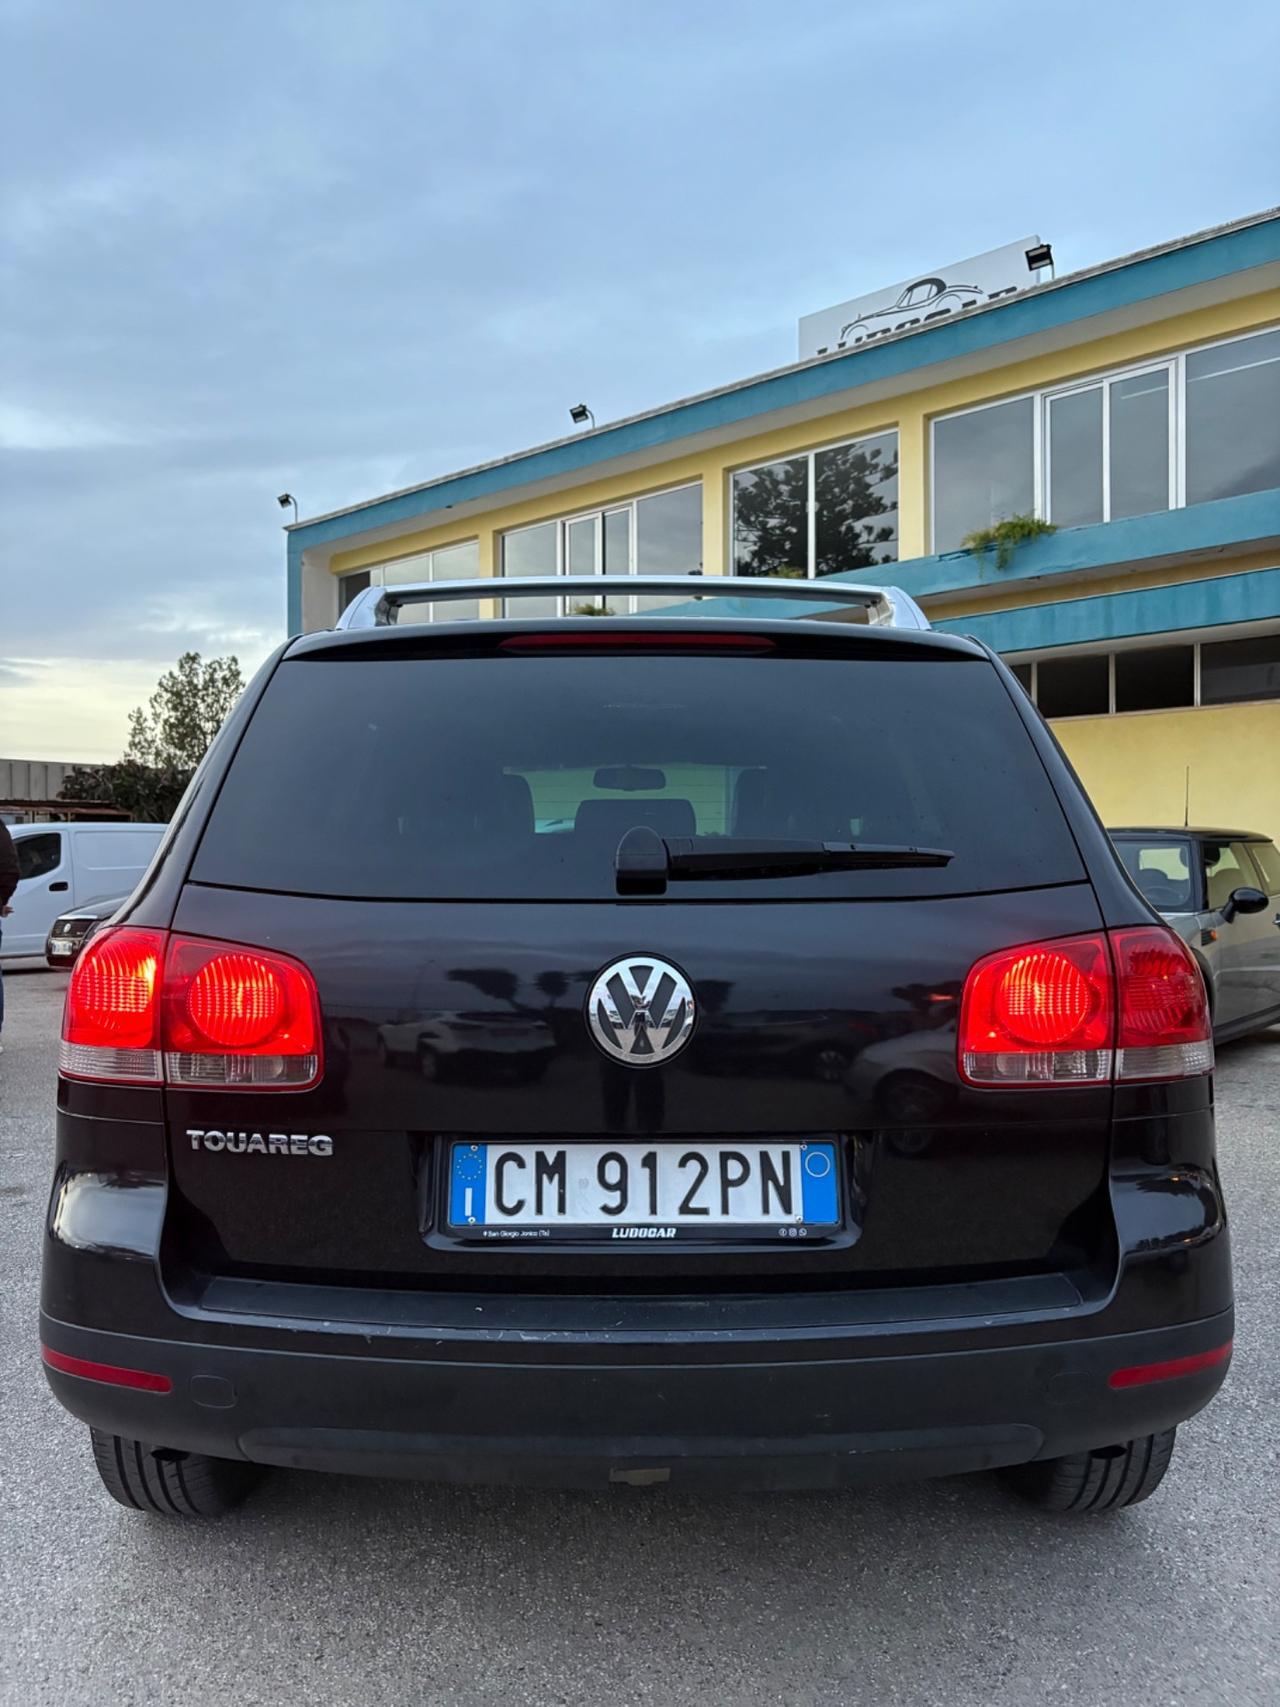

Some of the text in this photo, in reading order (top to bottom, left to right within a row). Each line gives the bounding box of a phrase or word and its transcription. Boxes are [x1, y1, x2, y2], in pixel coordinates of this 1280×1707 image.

[186, 1129, 334, 1157] TOUAREG
[494, 1150, 793, 1217] CM 912PN
[611, 1227, 677, 1239] LUDOCAR
